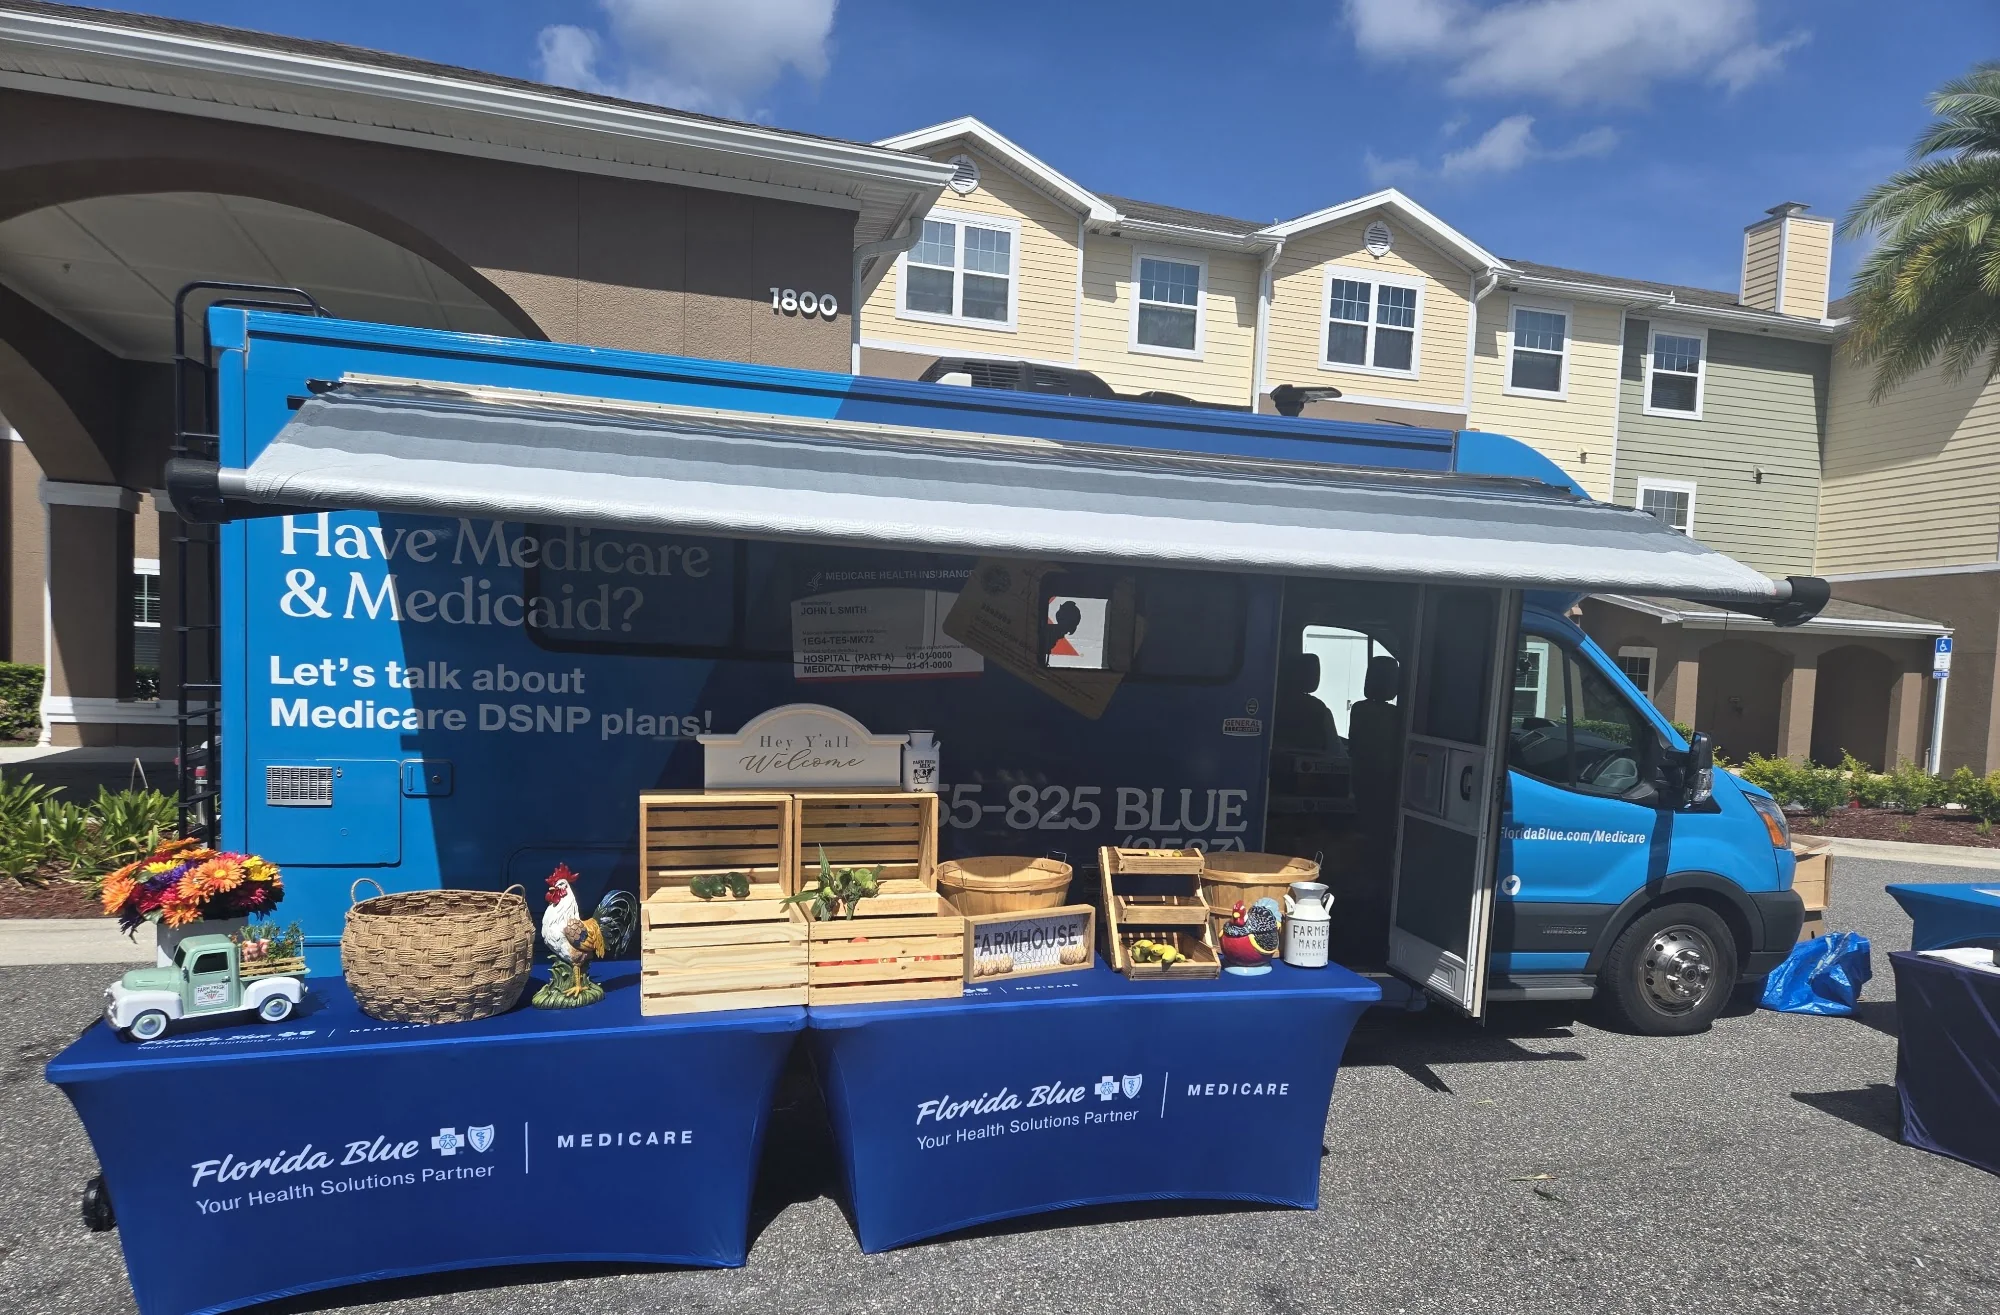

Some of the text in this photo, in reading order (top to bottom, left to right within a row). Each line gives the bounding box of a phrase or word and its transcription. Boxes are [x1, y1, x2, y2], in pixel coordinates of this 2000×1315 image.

[769, 287, 838, 316] 1800
[280, 511, 710, 577] Have Medicare
[825, 571, 876, 580] MEDICARE
[879, 571, 916, 580] HEALTH
[279, 569, 645, 633] & Medicaid?
[801, 605, 867, 616] JOHN L SMITH
[803, 652, 894, 663] HOSPITAL (PART A)
[906, 651, 952, 660] 01-01-0000
[384, 658, 461, 690] talk
[472, 664, 585, 695] about
[803, 664, 847, 674] MEDICAL
[270, 697, 712, 741] Medicare DSNP plans!
[1225, 719, 1260, 727] GENERAL
[760, 735, 793, 750] Hey
[739, 749, 865, 774] Welcome
[1114, 787, 1248, 832] BLUE
[1298, 938, 1327, 949] MARKE
[1187, 1082, 1290, 1097] MEDICARE
[916, 1081, 1085, 1125] Florida Blue
[557, 1130, 693, 1148] MEDICARE
[917, 1108, 1139, 1150] Your Health Solutions Partner
[191, 1134, 419, 1188] Florida Blue
[196, 1163, 495, 1216] Your Health Solutions Partner
